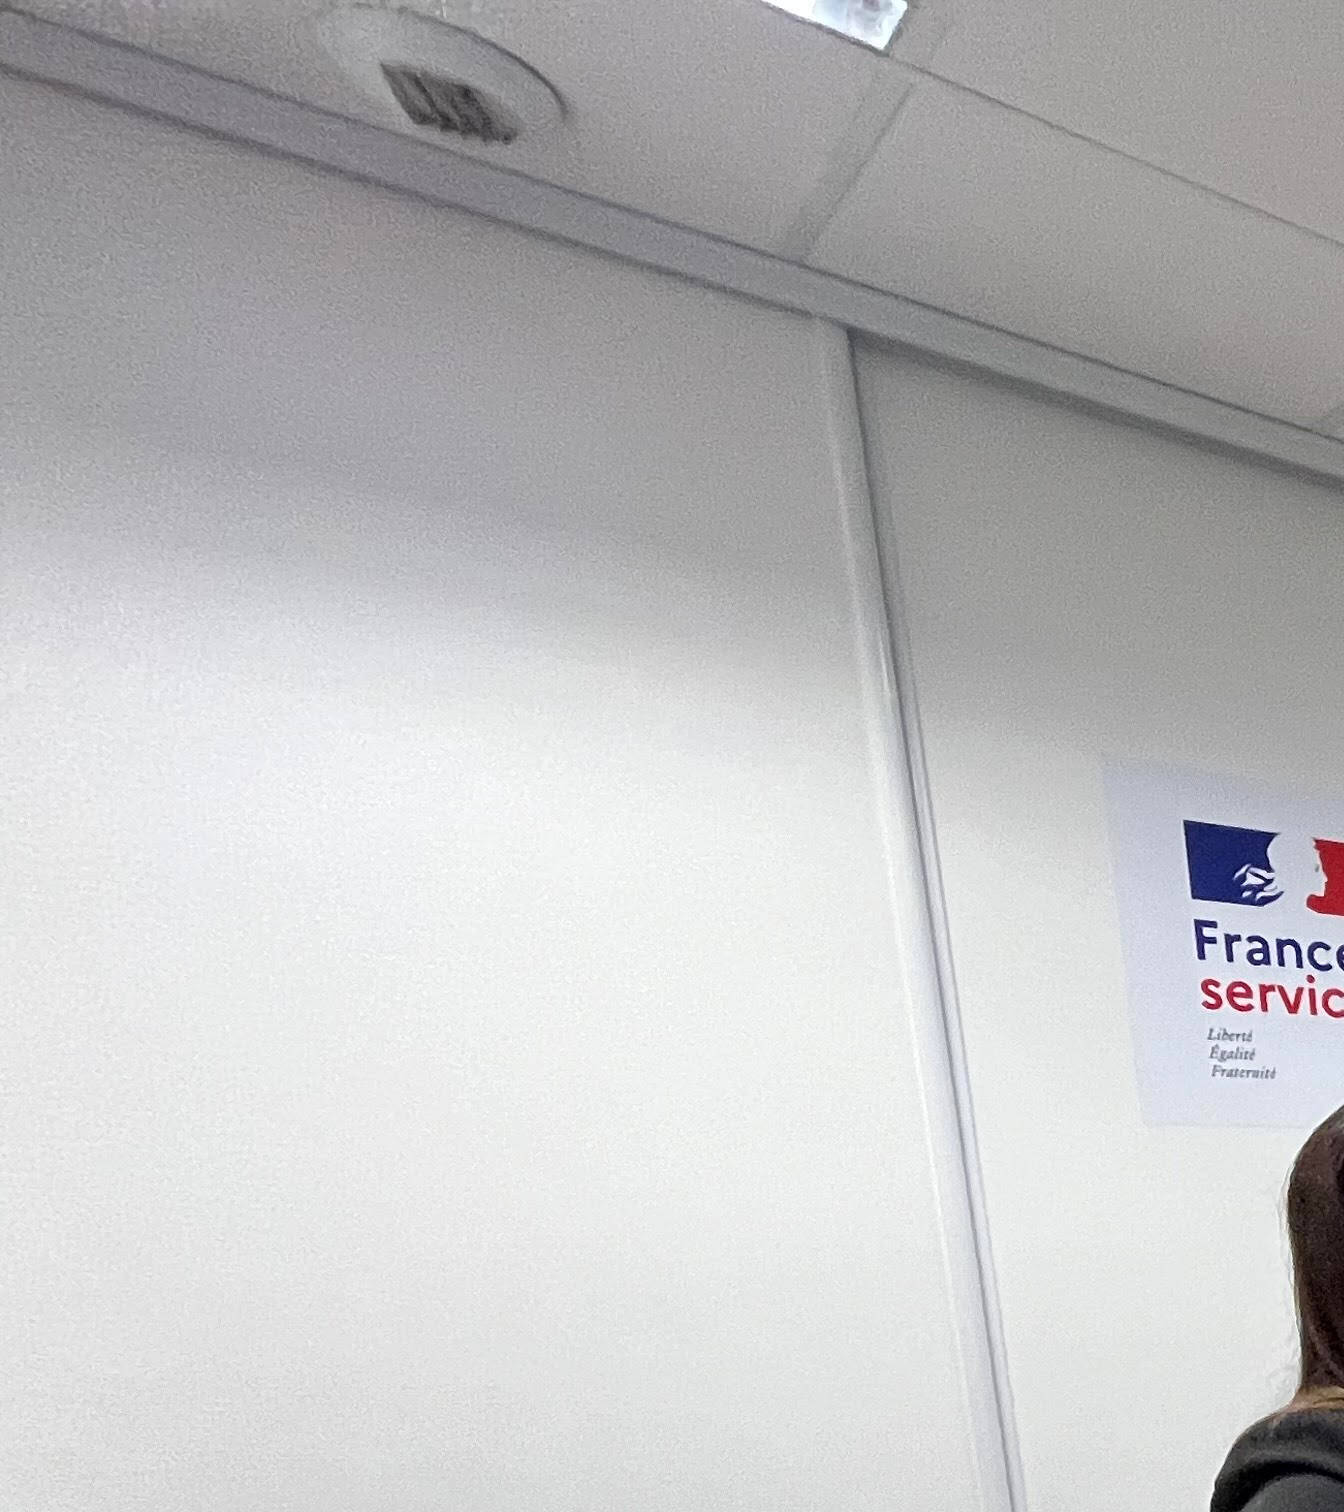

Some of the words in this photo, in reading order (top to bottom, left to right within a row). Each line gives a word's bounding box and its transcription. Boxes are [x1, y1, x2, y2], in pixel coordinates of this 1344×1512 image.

[1207, 1027, 1254, 1042] Liberté
[1209, 1044, 1256, 1063] Égalité
[1211, 1064, 1277, 1080] Fraternité
